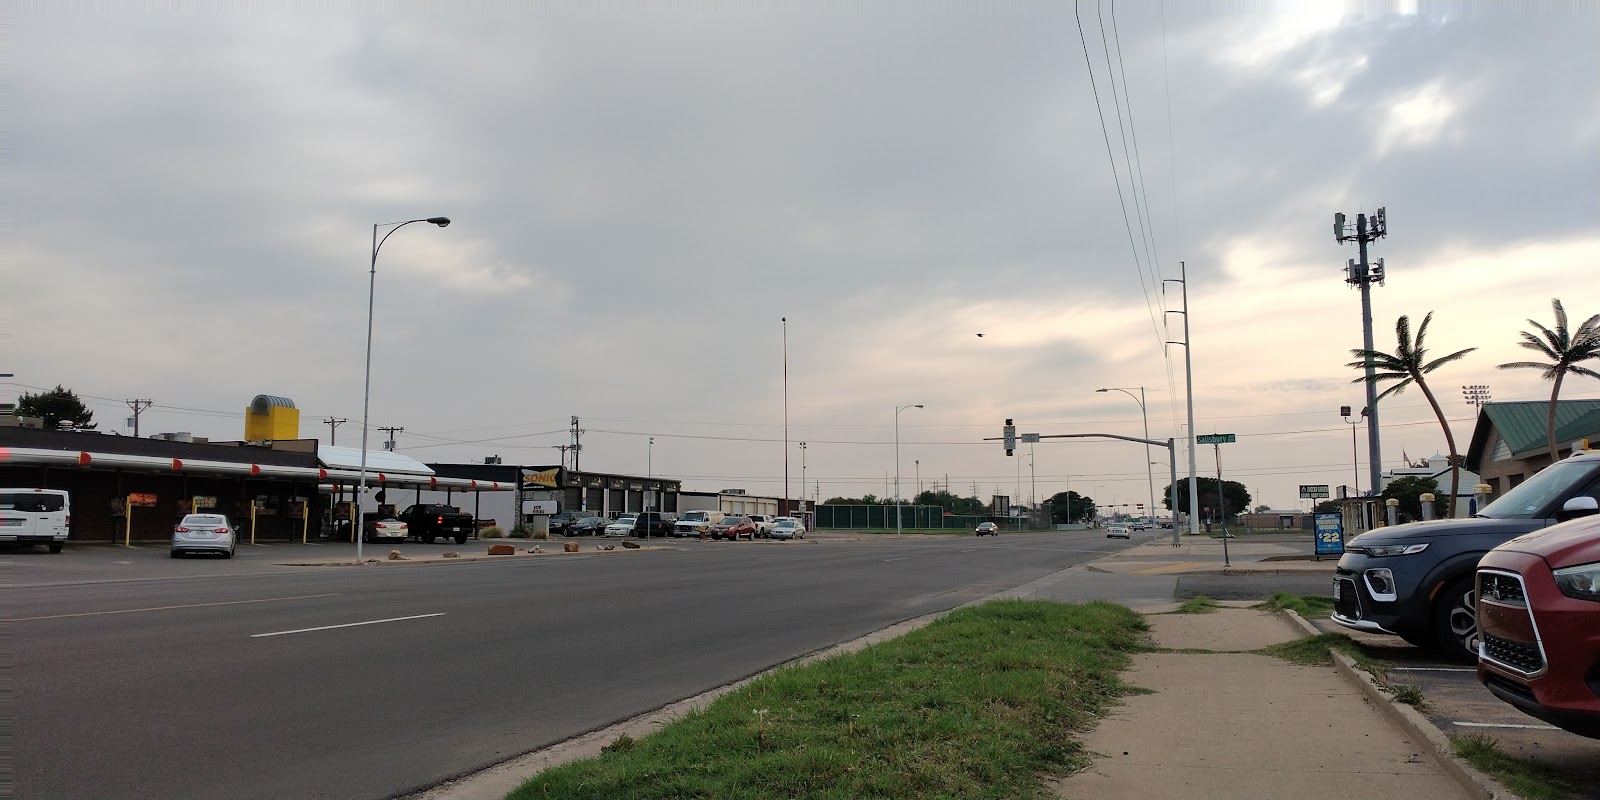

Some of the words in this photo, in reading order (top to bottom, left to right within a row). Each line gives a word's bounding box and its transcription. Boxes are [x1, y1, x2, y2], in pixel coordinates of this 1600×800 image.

[1197, 435, 1227, 443] Salisbury
[523, 473, 556, 482] SONIC
[1318, 532, 1340, 543] $22
